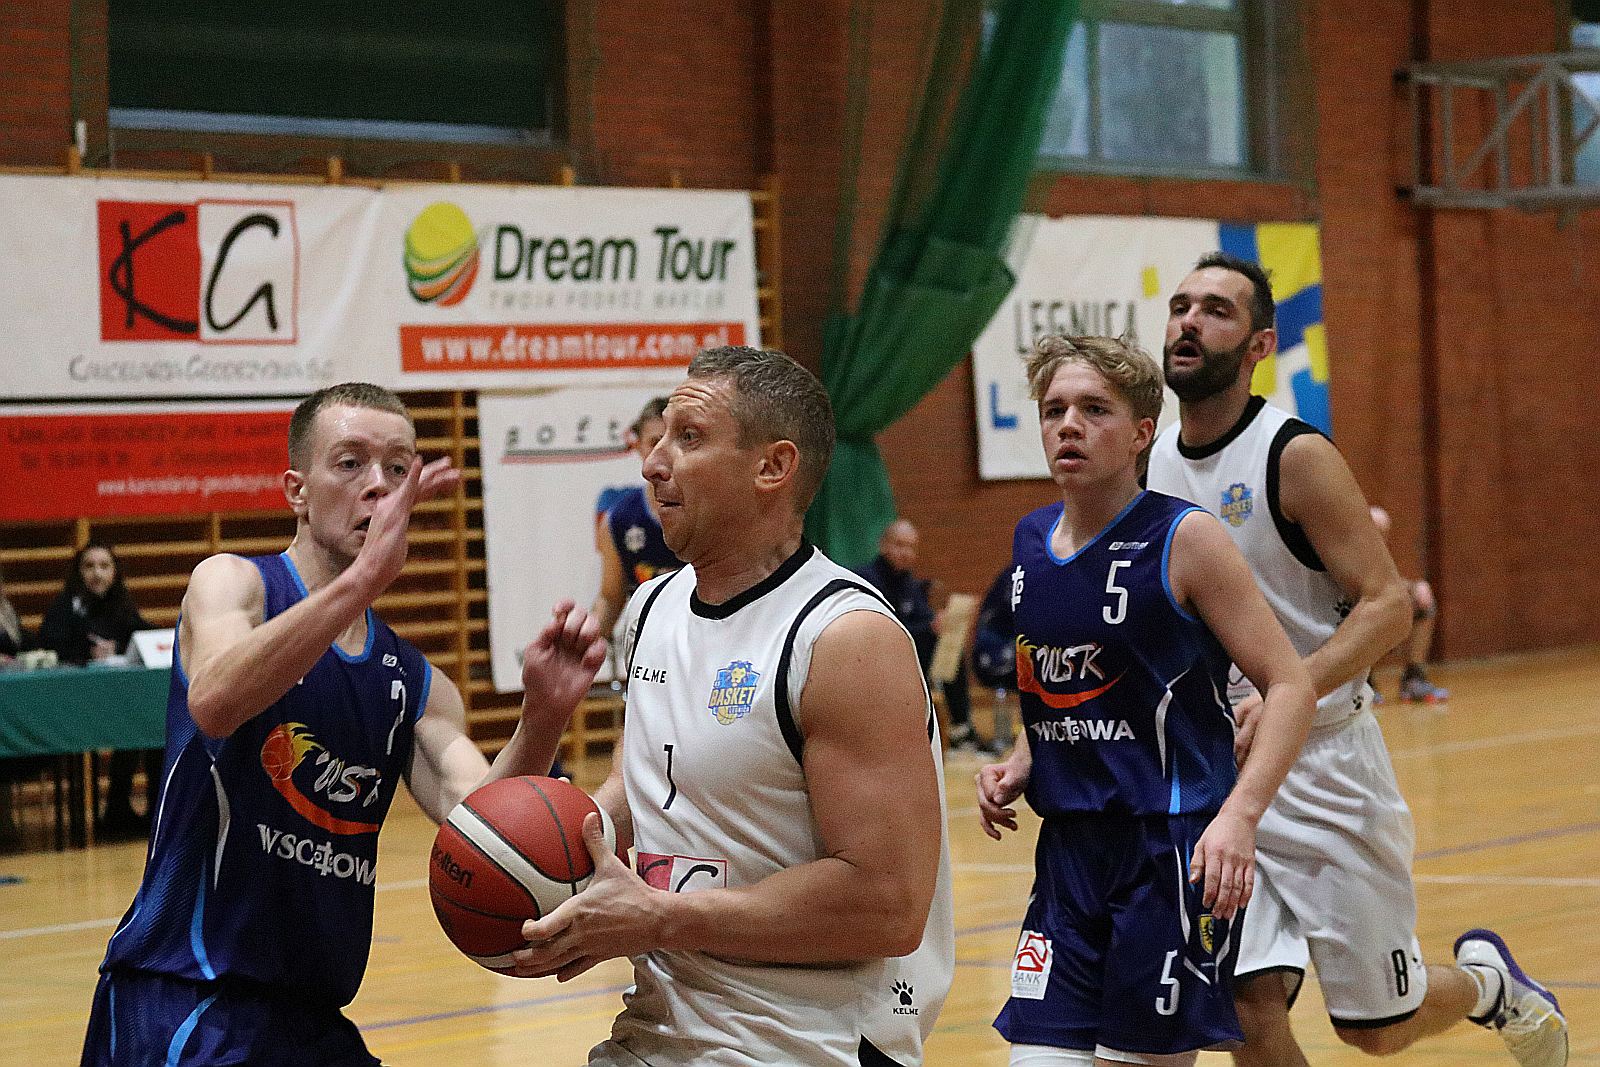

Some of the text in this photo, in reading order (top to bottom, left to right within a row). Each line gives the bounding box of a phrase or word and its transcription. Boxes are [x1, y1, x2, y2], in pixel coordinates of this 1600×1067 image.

[493, 225, 736, 282] Dream Tour
[421, 326, 728, 363] www.dreamtour.coml
[1102, 560, 1131, 624] 5
[385, 680, 406, 755] 7
[708, 686, 757, 708] BASKET
[1155, 950, 1181, 1016] 5
[1391, 949, 1408, 997] 8
